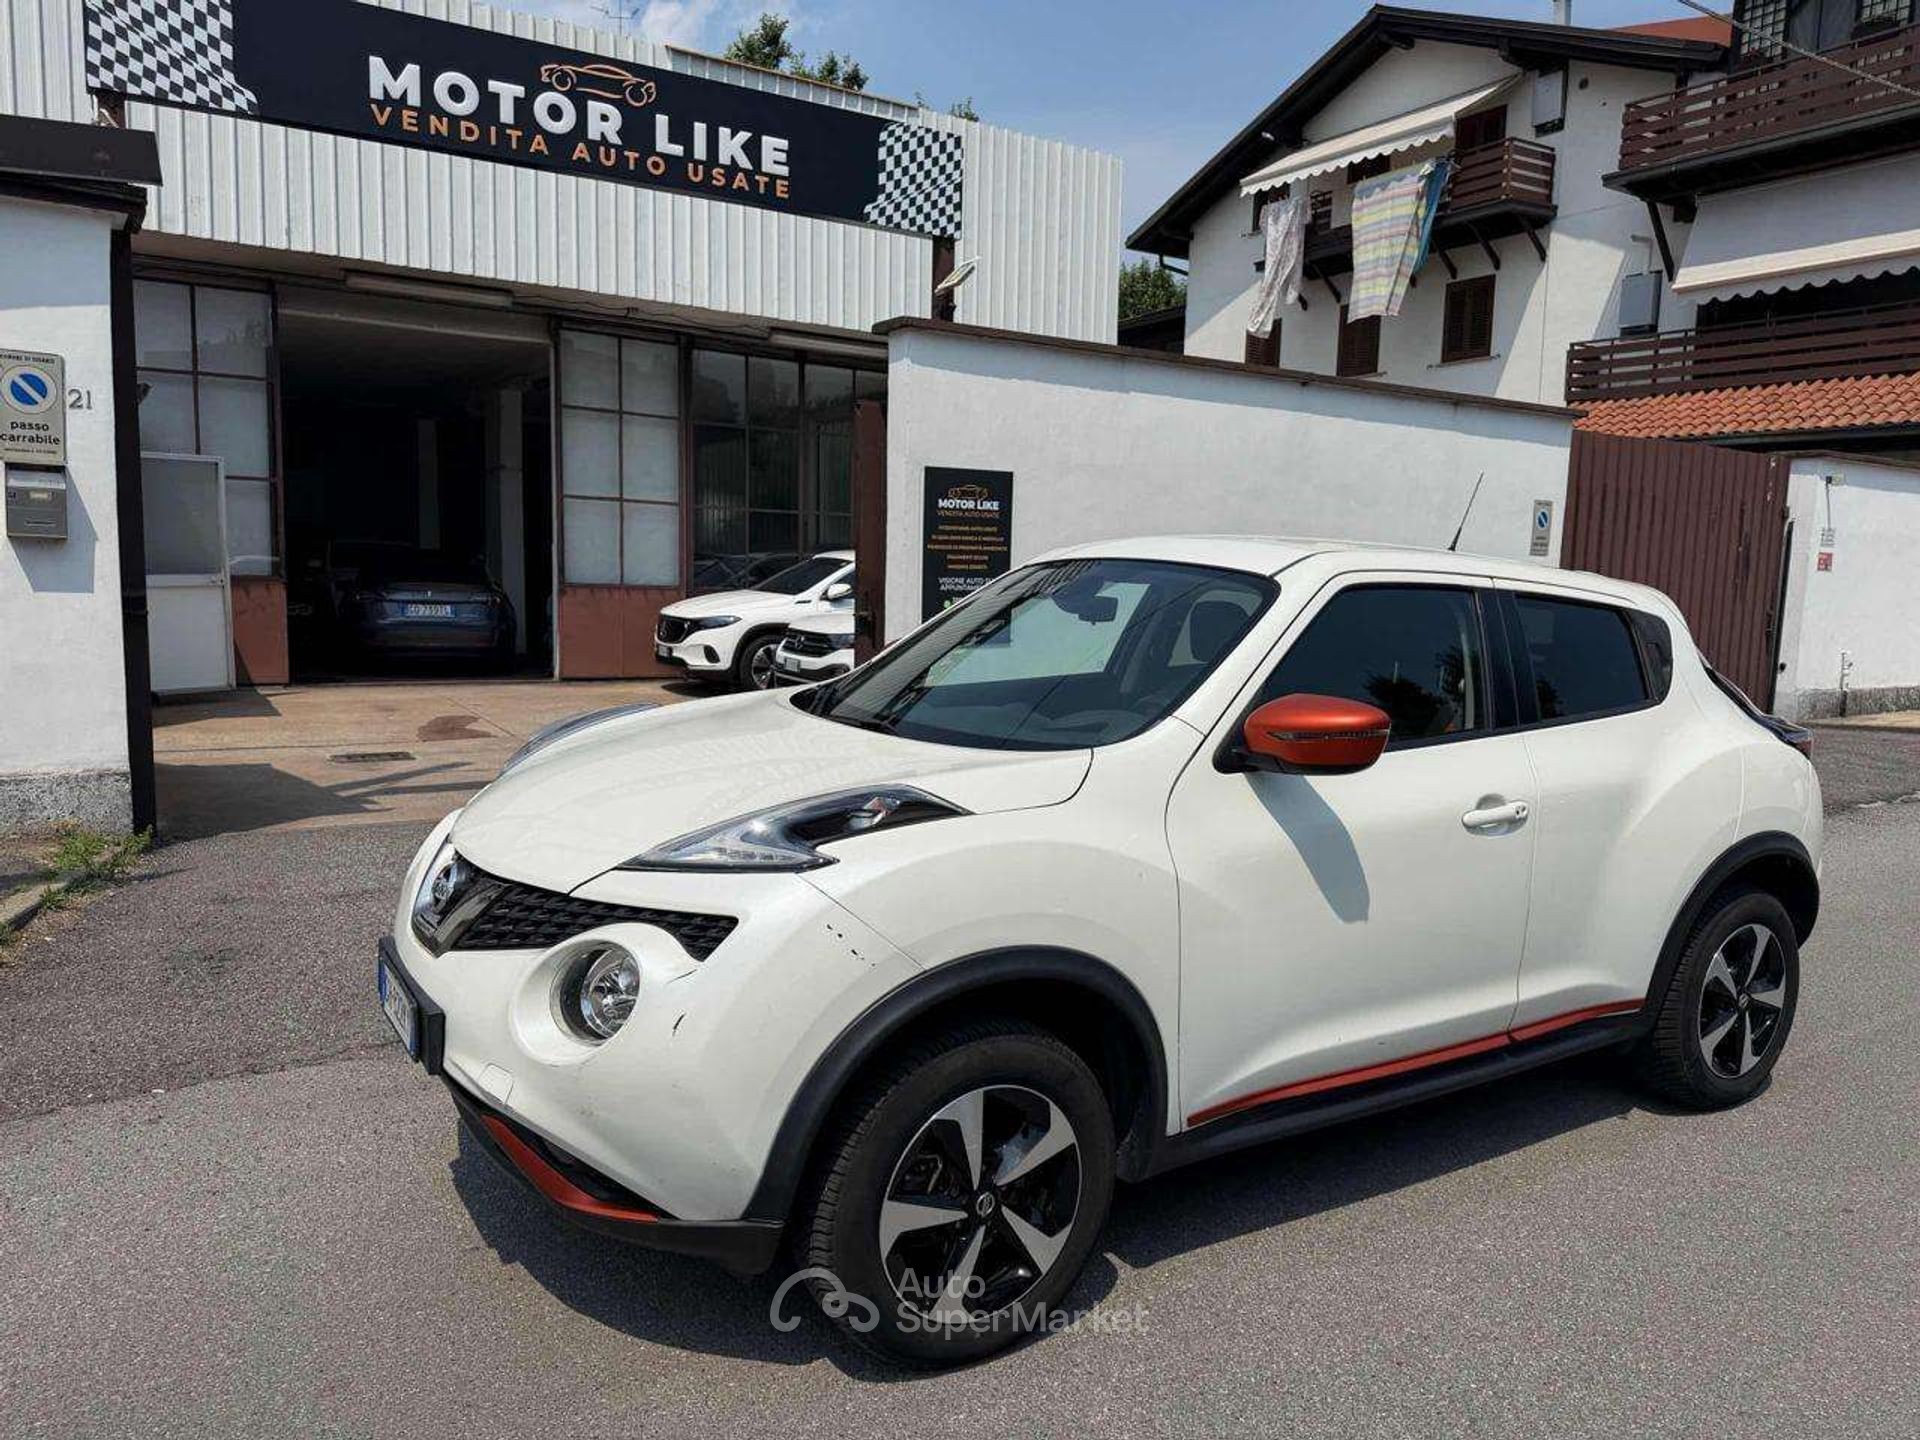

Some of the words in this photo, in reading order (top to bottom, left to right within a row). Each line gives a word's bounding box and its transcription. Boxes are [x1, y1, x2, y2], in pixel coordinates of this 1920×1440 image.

[368, 55, 623, 145] MOTOR
[655, 113, 790, 177] LIKE
[370, 103, 549, 155] VENDITA
[571, 142, 666, 176] AUTO
[687, 164, 790, 198] USATE
[67, 388, 93, 410] 21
[10, 420, 50, 432] passo
[0, 431, 61, 446] carrabile
[938, 498, 975, 510] MOTOR
[977, 500, 1000, 511] LIKE
[966, 577, 984, 585] AUTO
